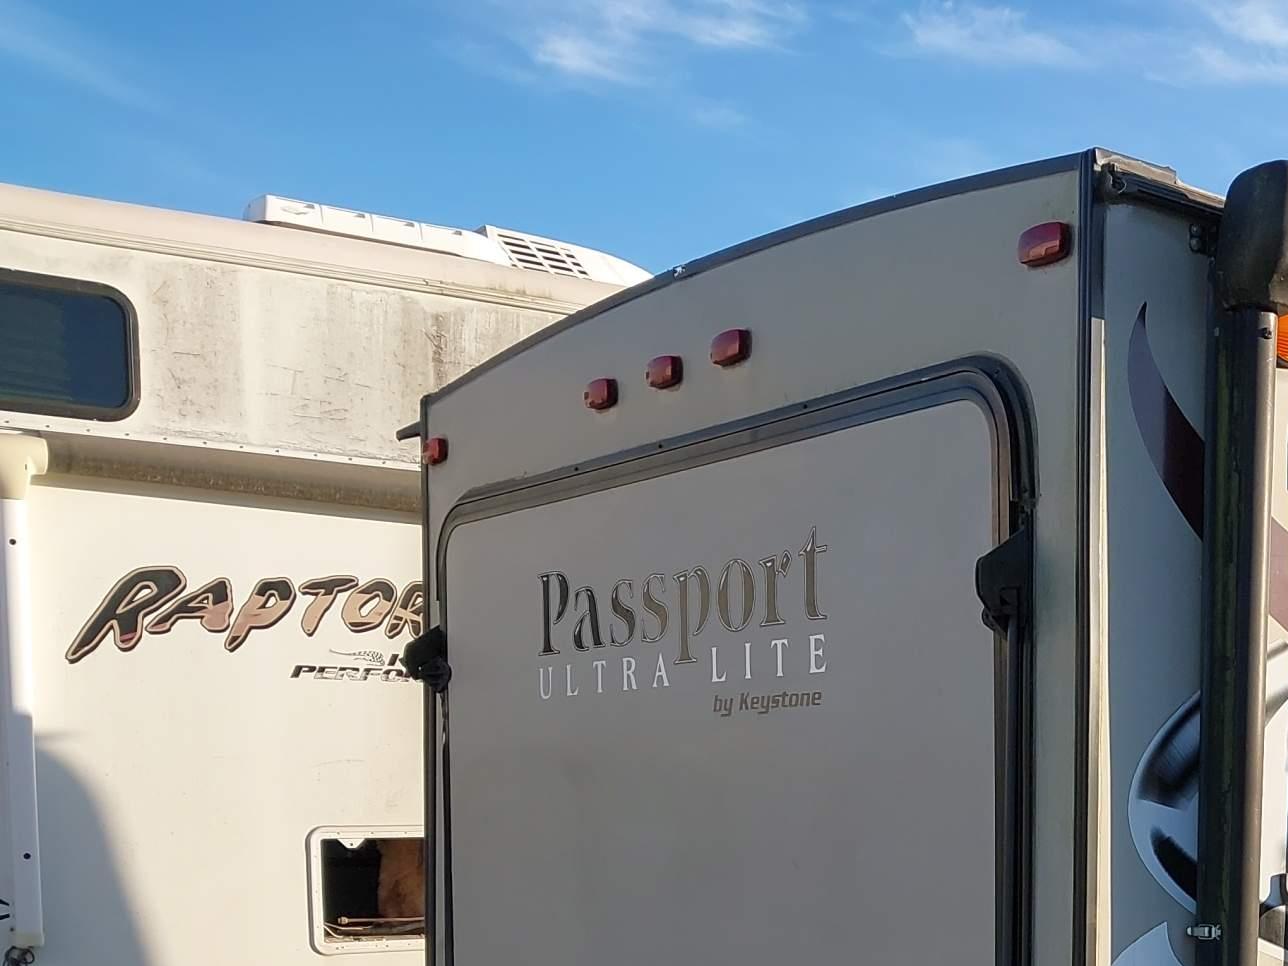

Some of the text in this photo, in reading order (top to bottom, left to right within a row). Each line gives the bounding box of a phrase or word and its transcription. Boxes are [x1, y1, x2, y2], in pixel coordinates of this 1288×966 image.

[65, 565, 424, 664] RAPTOR
[537, 525, 828, 665] Passport
[290, 665, 410, 682] PERFO
[539, 633, 828, 700] ULTRA LITE
[713, 690, 822, 717] by Keystone
